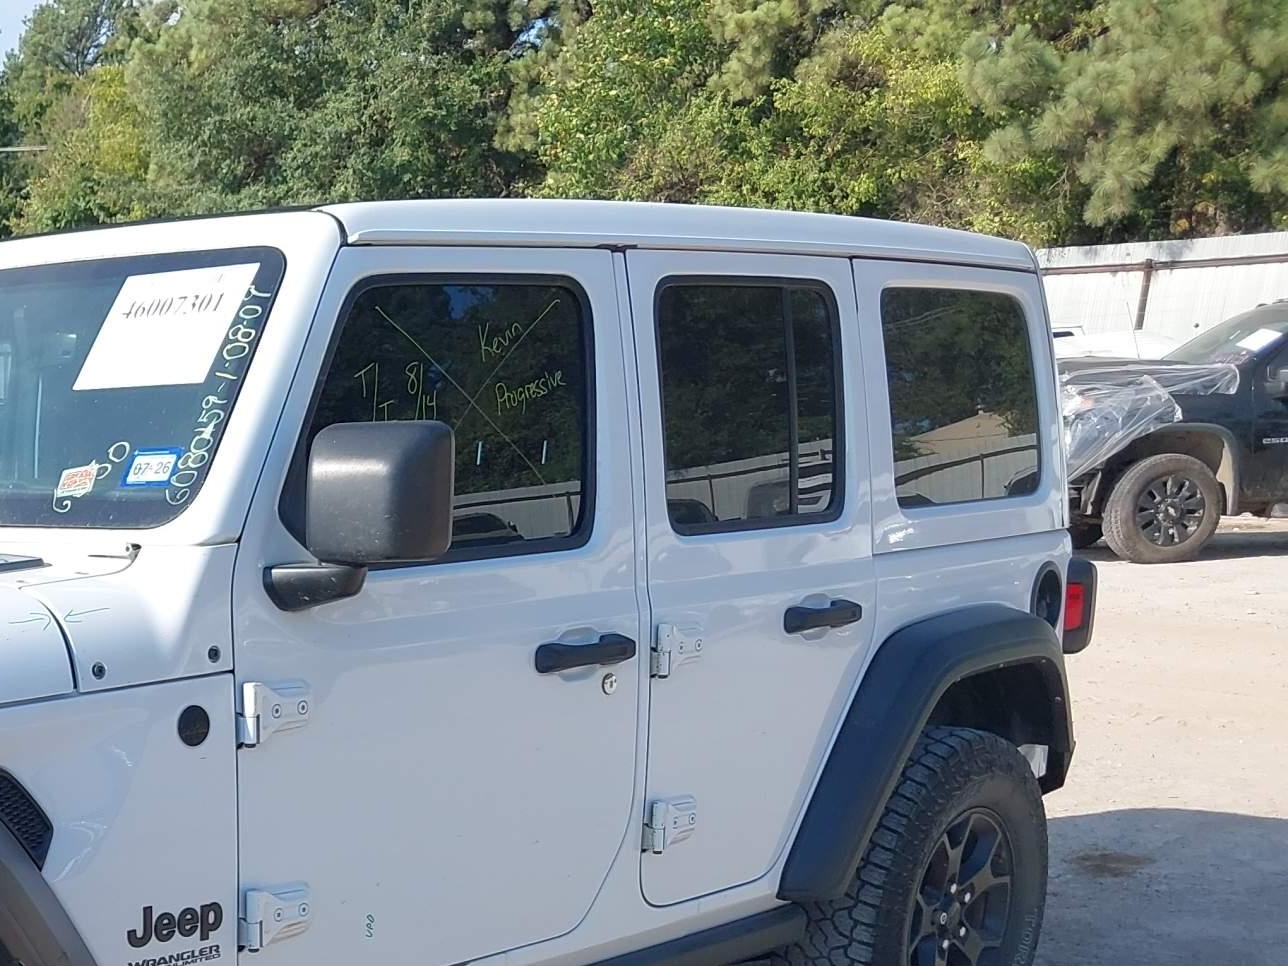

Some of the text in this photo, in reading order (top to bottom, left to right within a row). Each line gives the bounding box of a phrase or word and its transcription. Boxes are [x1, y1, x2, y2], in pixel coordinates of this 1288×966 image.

[122, 292, 225, 320] 46007301
[478, 321, 524, 362] Kevin
[495, 369, 568, 416] Progressive
[126, 901, 224, 949] Jeep
